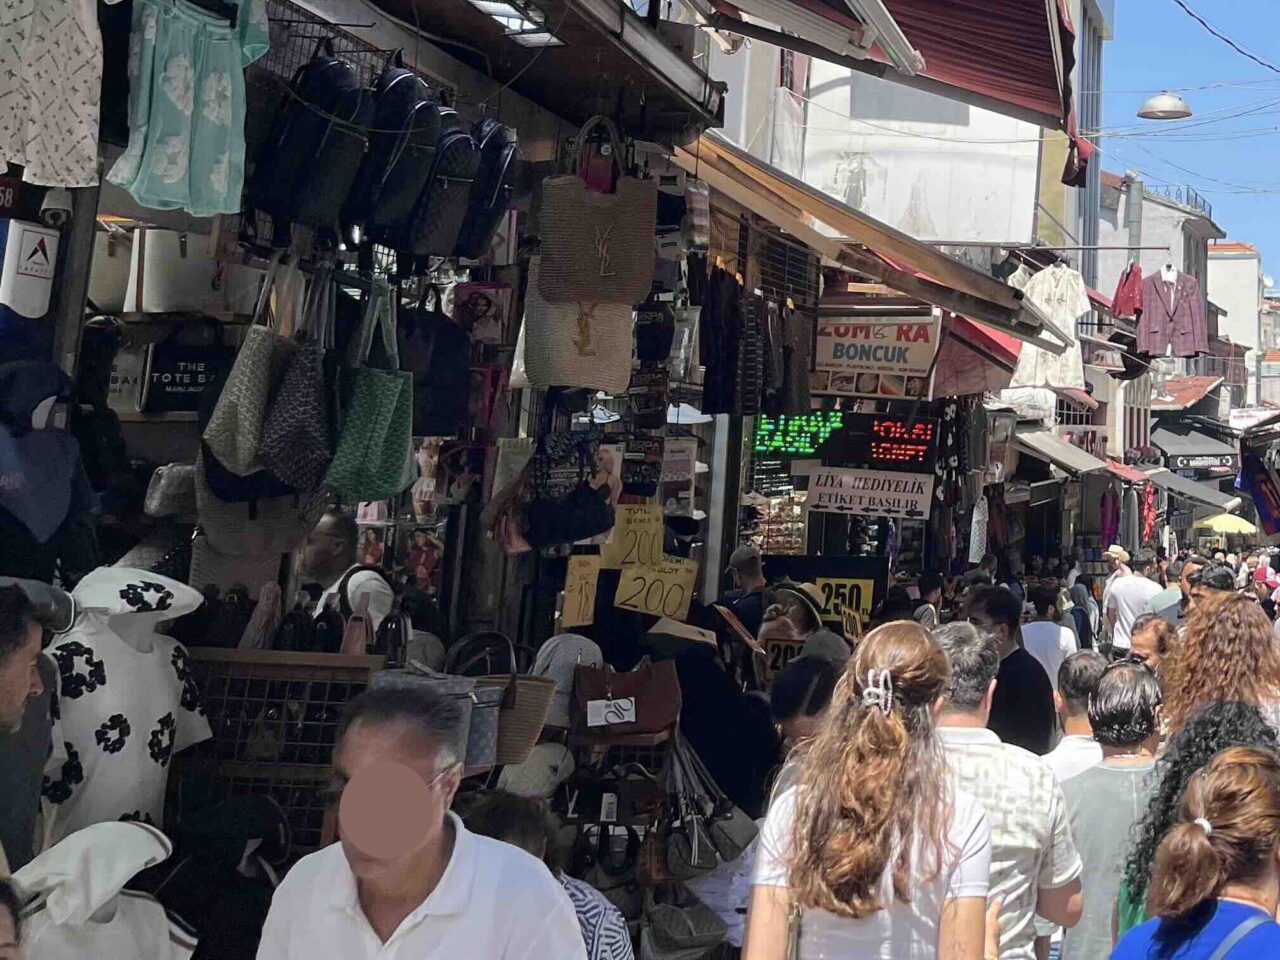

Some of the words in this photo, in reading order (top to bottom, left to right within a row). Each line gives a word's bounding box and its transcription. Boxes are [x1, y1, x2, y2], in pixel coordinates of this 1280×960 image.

[832, 342, 910, 364] BONCUK
[177, 362, 206, 371] THE
[151, 373, 191, 383] TOTE
[815, 472, 843, 488] LİYA
[851, 474, 926, 494] HEDİYELİK
[818, 492, 865, 505] ETİKET
[868, 497, 918, 509] BASILIR
[619, 576, 685, 617] 200
[821, 583, 861, 615] 250
